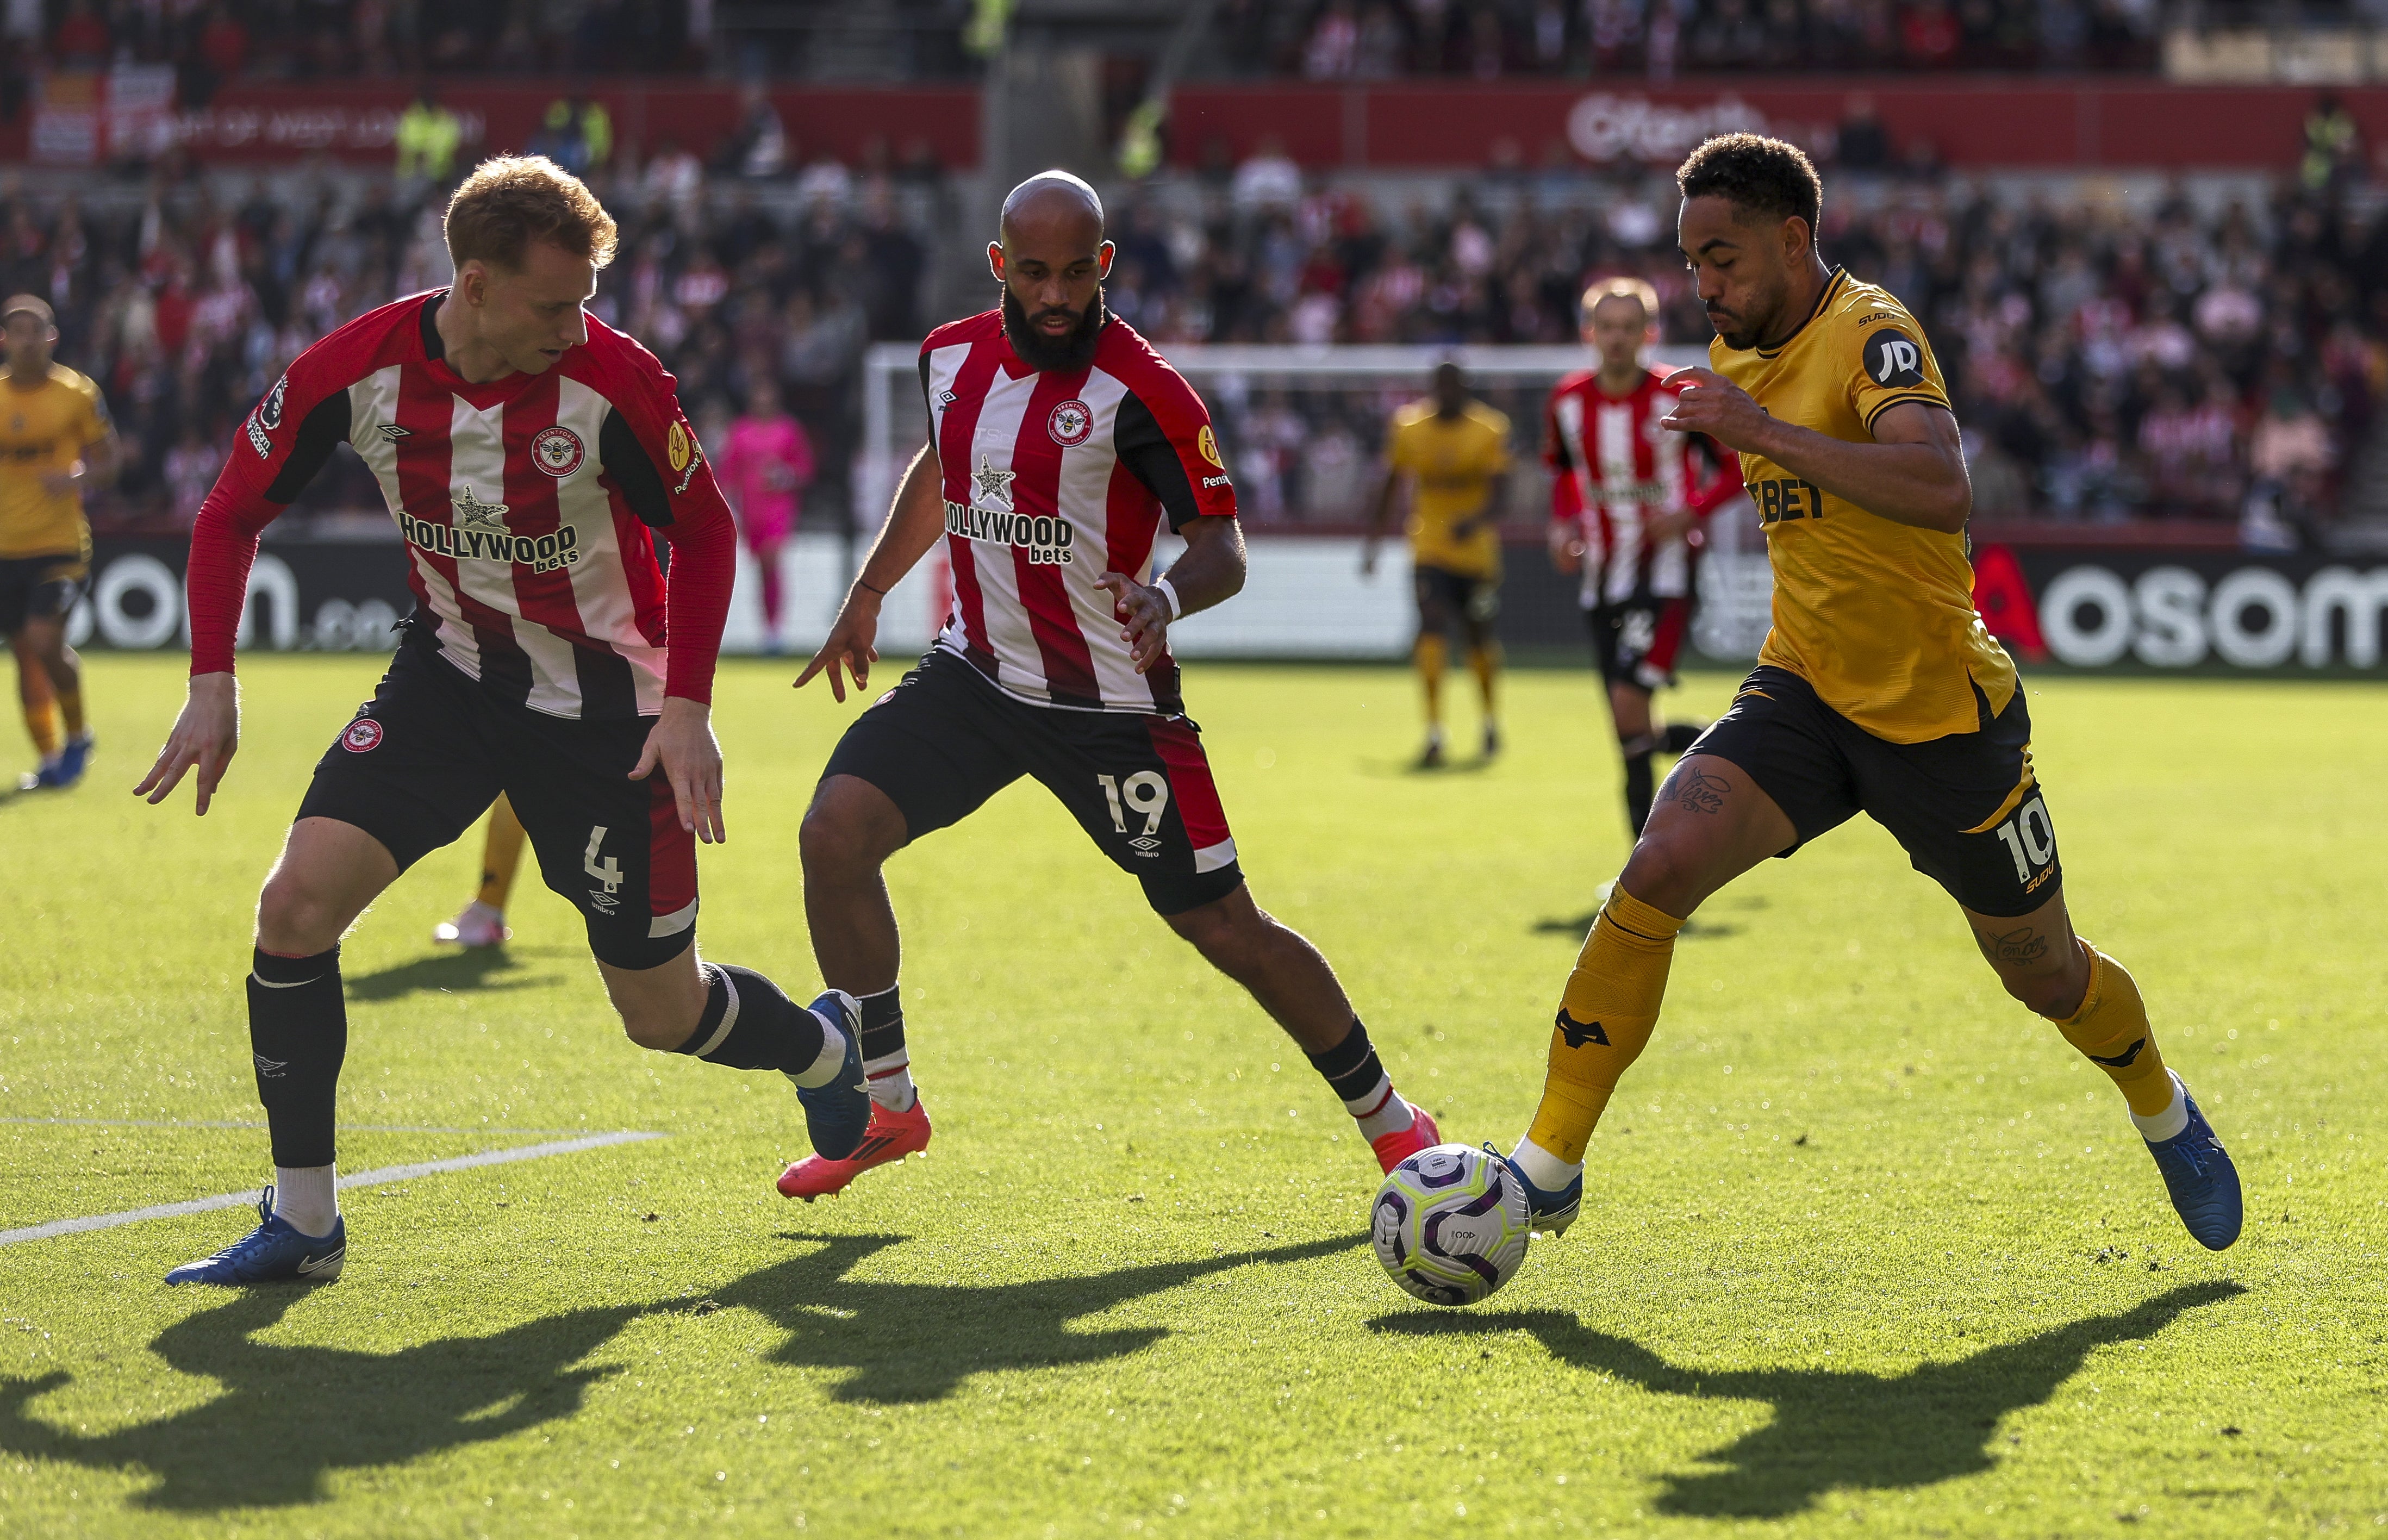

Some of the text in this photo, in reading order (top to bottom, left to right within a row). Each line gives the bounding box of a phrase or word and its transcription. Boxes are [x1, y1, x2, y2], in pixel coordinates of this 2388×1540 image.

[1879, 341, 1917, 382] JD
[1057, 403, 1088, 416] BRENTFORD
[382, 435, 410, 447] umo
[538, 430, 576, 442] BRENTFORD
[538, 462, 577, 475] FOOTBALL CLUB
[398, 512, 577, 563] HOLLYWOOD
[535, 550, 579, 573] bets
[1031, 545, 1072, 563] bets
[1097, 770, 1168, 836] 19
[1997, 797, 2053, 884] 10
[584, 825, 624, 894] 4
[1135, 850, 1159, 858] umbro
[2026, 859, 2054, 894] SUDU
[591, 901, 615, 916] umbro
